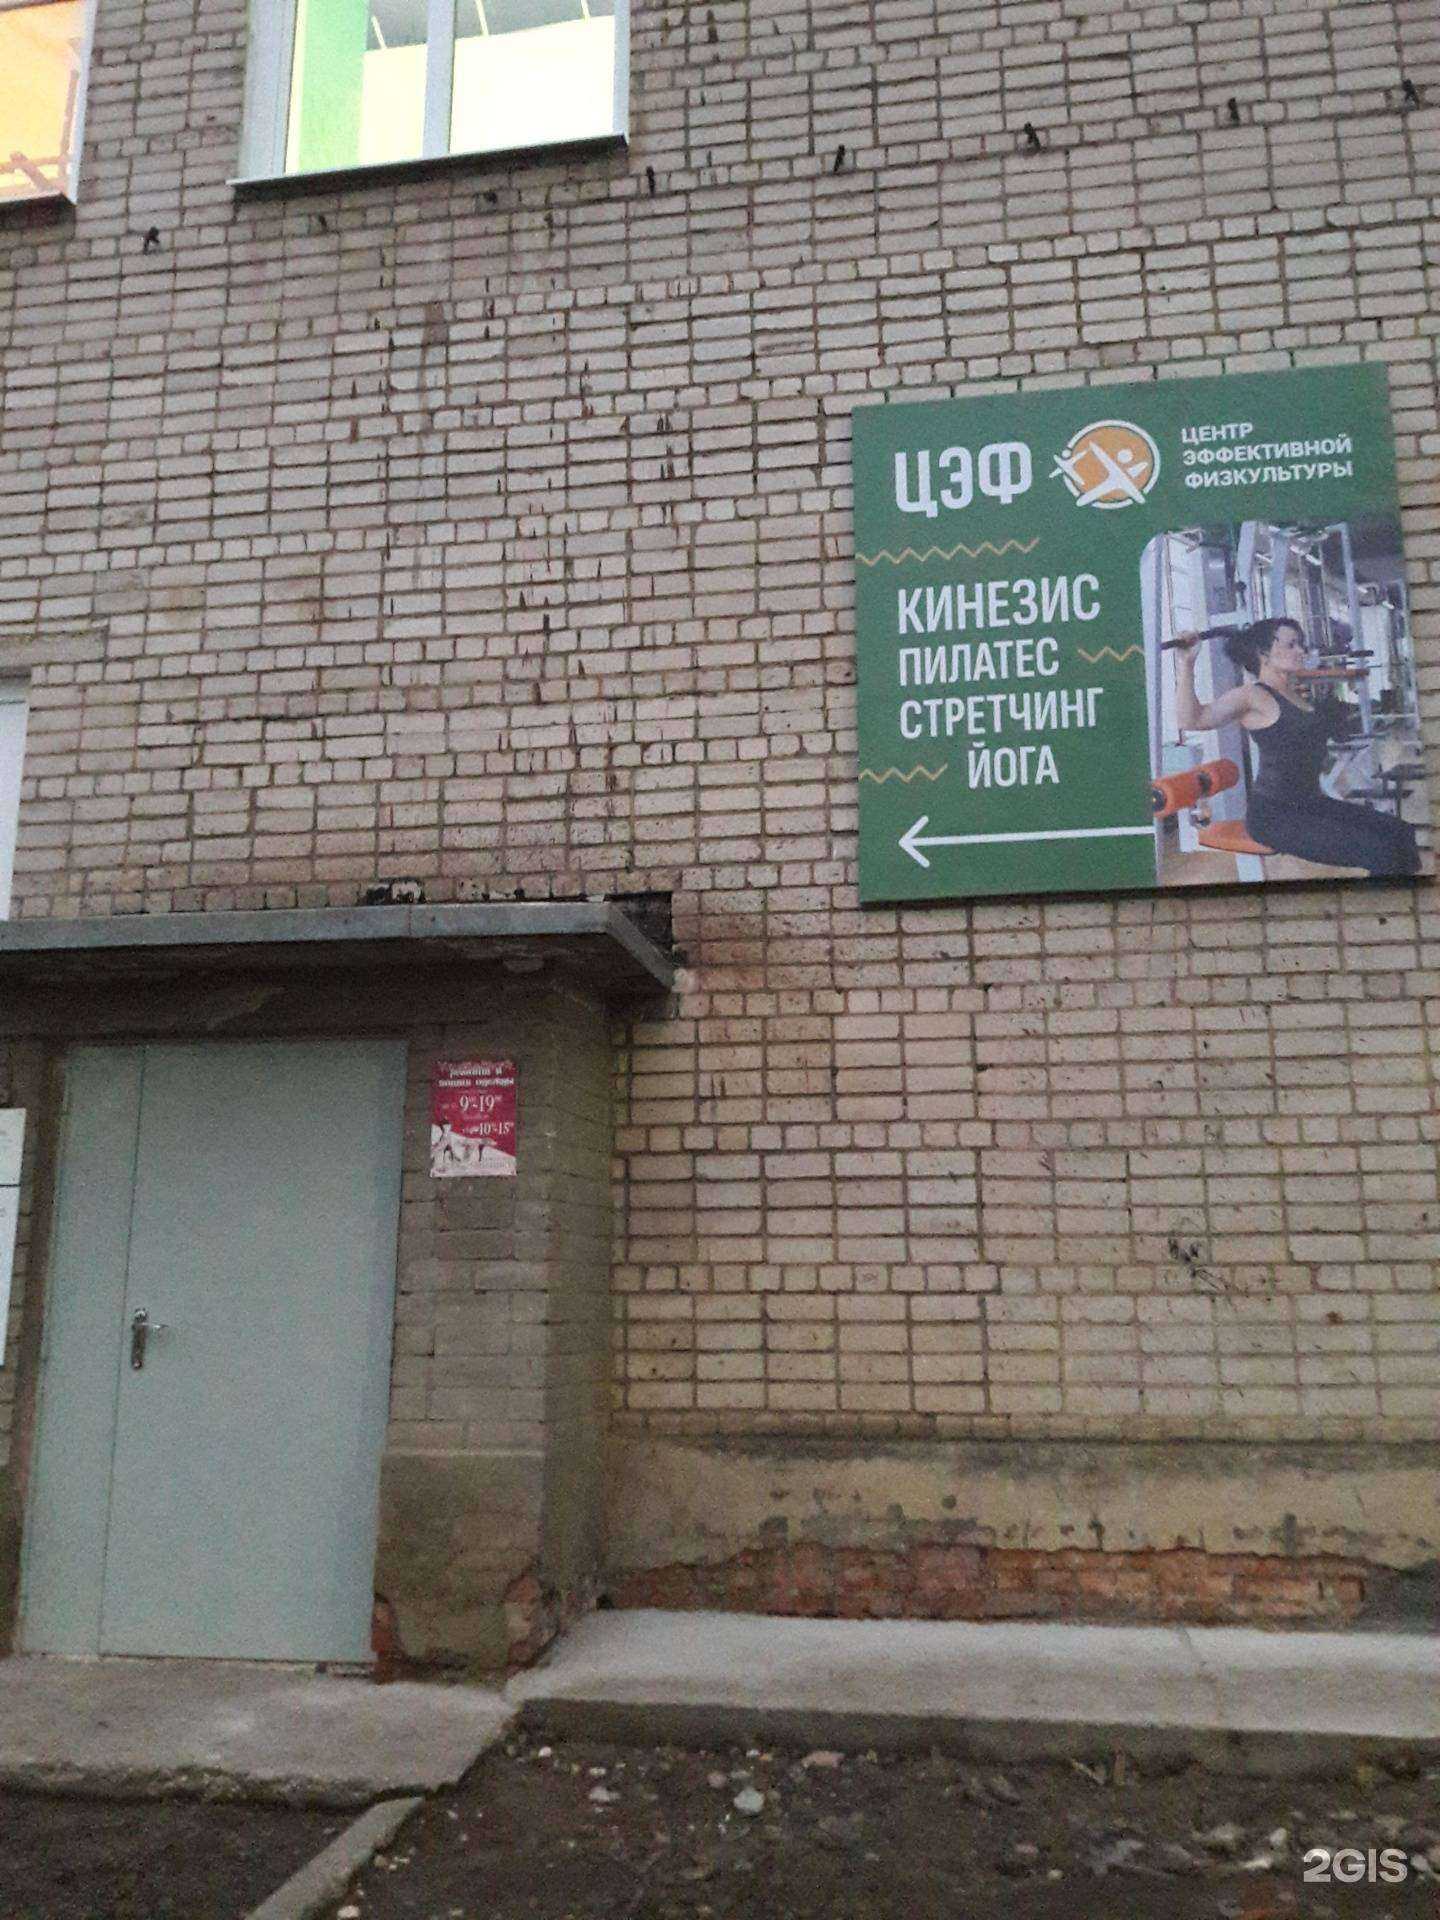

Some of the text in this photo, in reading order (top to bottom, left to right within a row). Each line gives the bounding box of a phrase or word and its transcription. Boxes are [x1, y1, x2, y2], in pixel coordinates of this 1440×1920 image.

[1181, 422, 1253, 445] ЦЕНТР
[1183, 433, 1353, 466] ЭФФЕКТИВНОЙ
[895, 442, 1033, 518] ЦЭФ
[1185, 460, 1353, 489] ФИЗКУЛЬТУРЫ
[898, 573, 1100, 634] КИНЕЗИС
[899, 637, 1059, 686] ПИЛАТЕС
[901, 687, 1103, 739] СТРЕТЧИНГ
[968, 741, 1060, 789] ЙОГА
